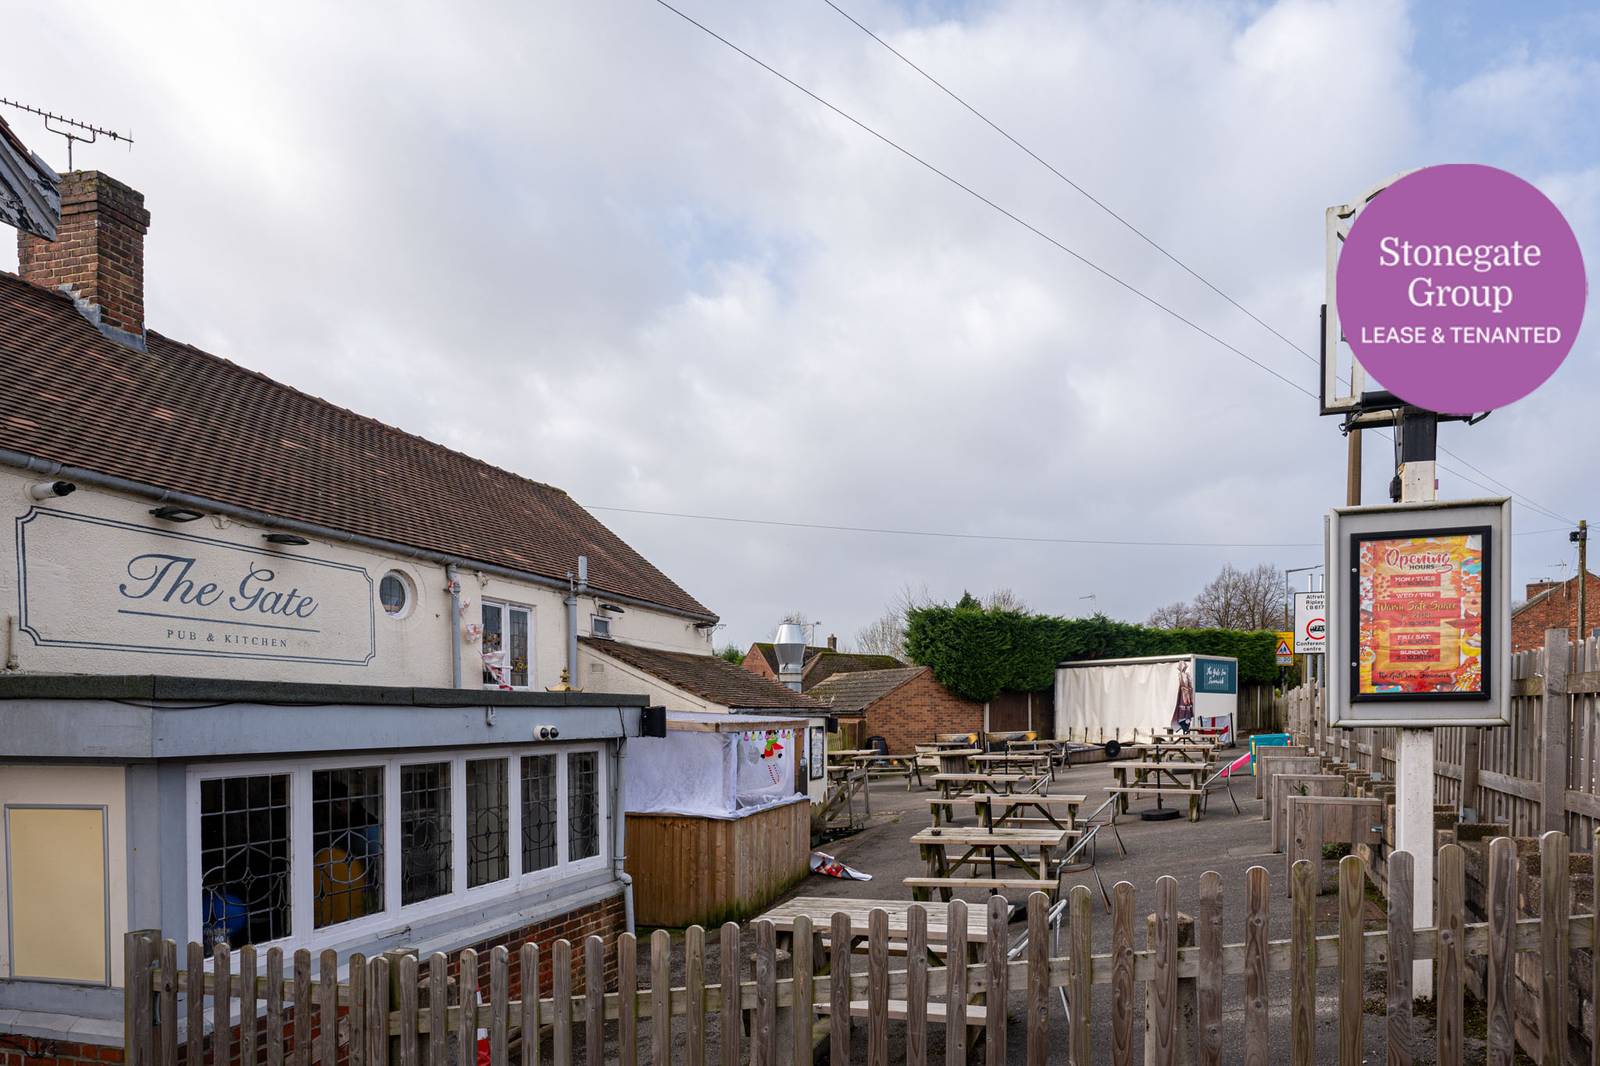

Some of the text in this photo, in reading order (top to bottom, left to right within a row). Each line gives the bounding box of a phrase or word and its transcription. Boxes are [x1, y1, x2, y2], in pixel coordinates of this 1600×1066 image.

[1385, 548, 1453, 574] Opening
[118, 553, 320, 619] The Gate
[167, 629, 288, 648] PUB & KITCHEN
